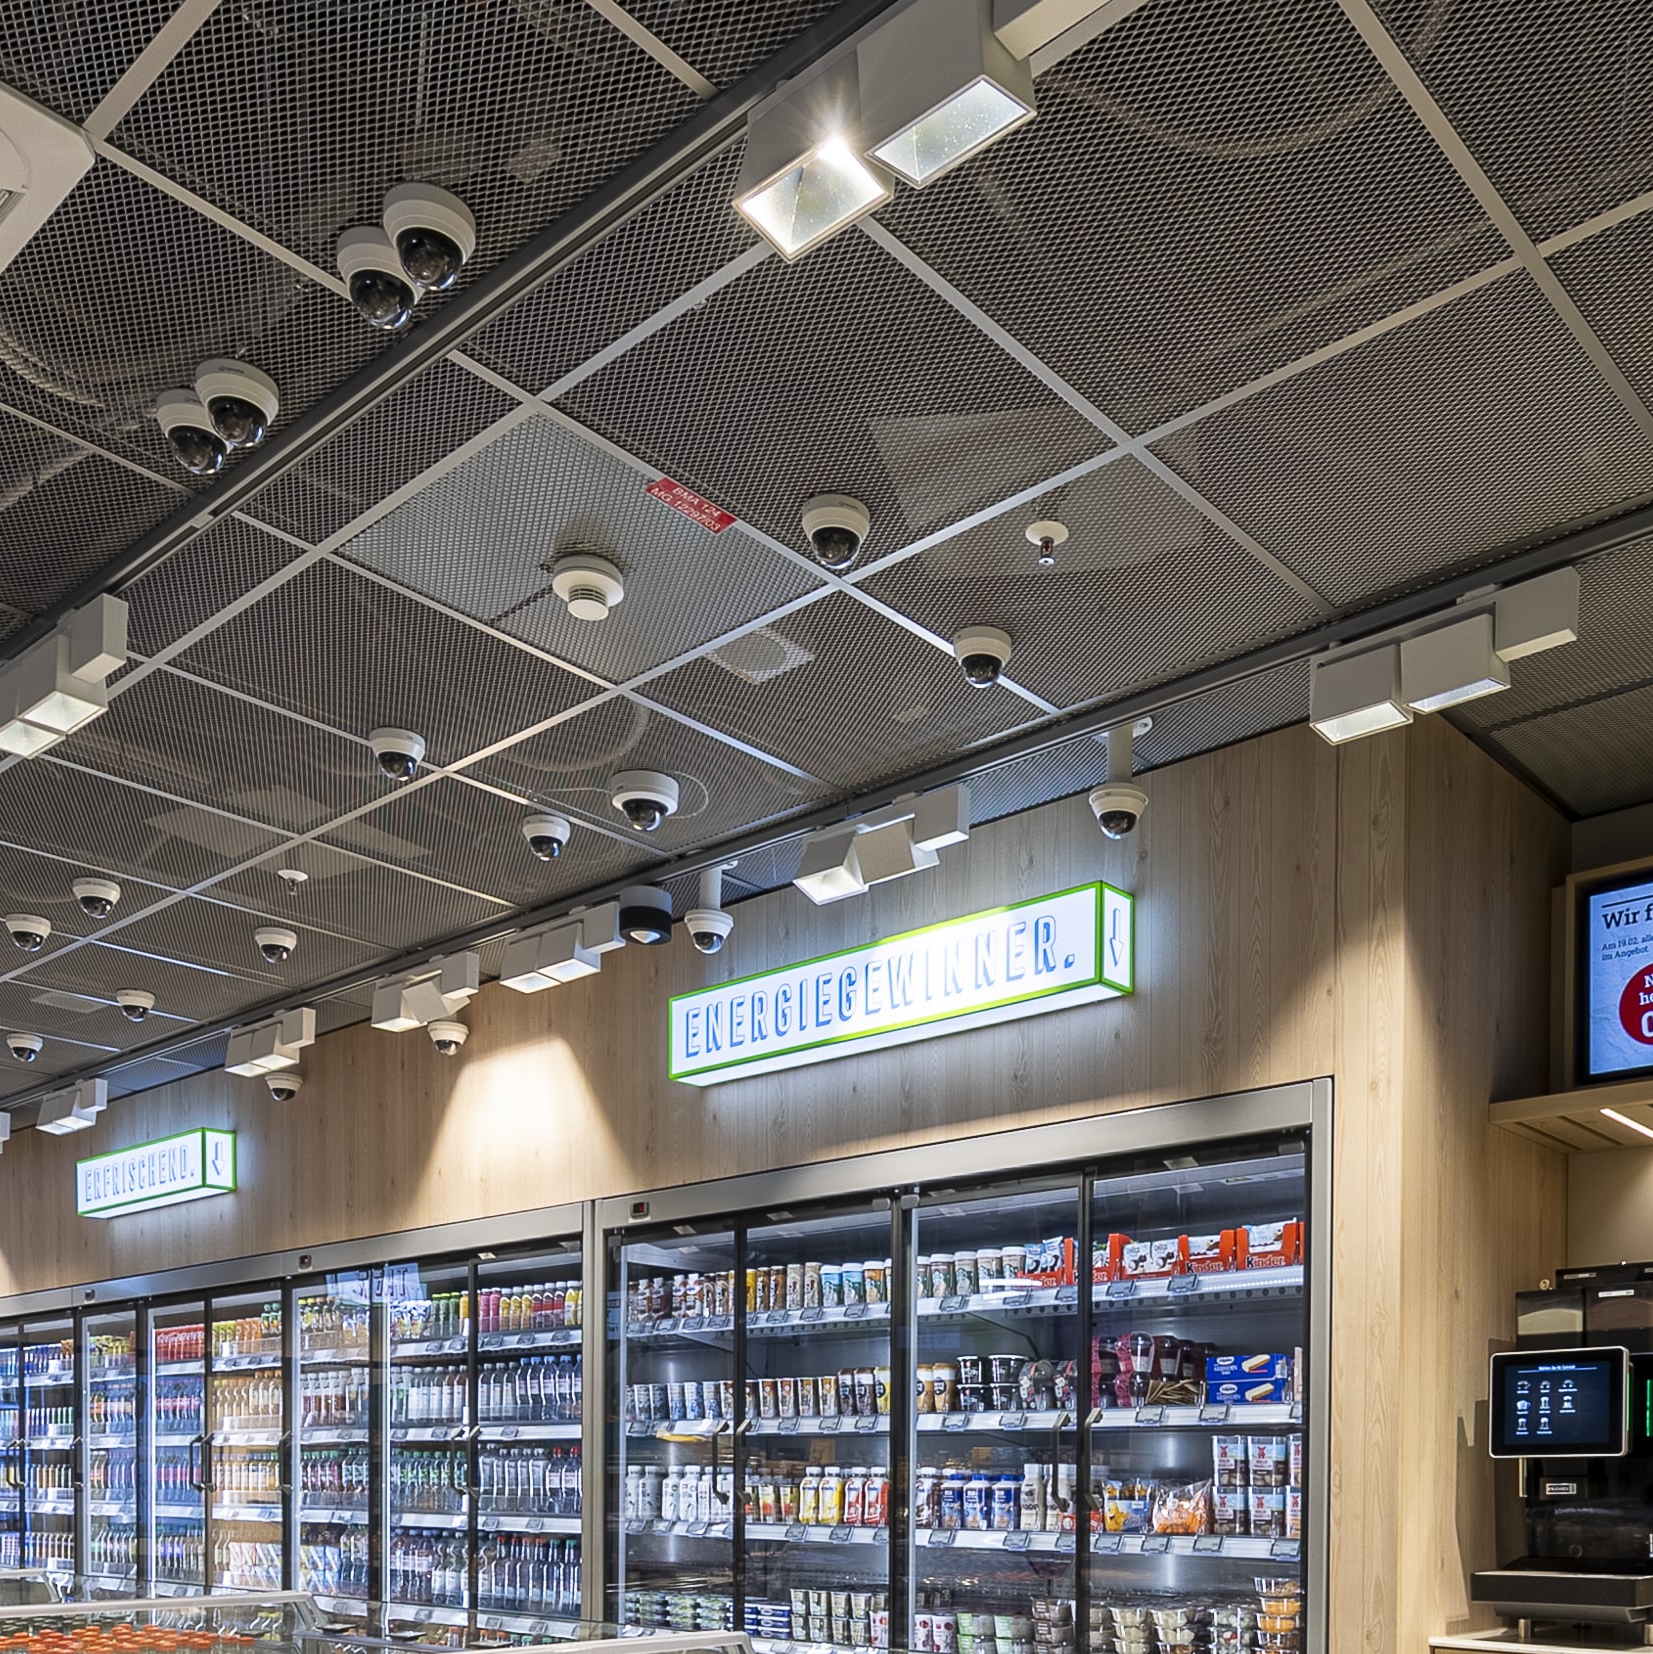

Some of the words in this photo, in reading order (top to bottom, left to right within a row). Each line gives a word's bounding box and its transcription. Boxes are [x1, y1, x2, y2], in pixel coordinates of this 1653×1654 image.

[651, 487, 673, 501] MG
[673, 487, 699, 505] BMA
[702, 504, 722, 517] 124
[1602, 906, 1640, 930] Wir
[1601, 942, 1617, 952] Am
[1601, 951, 1612, 961] im
[685, 915, 1076, 1058] ENERGIEGEWINNER.
[84, 1143, 195, 1203] ERFRISCHEND.
